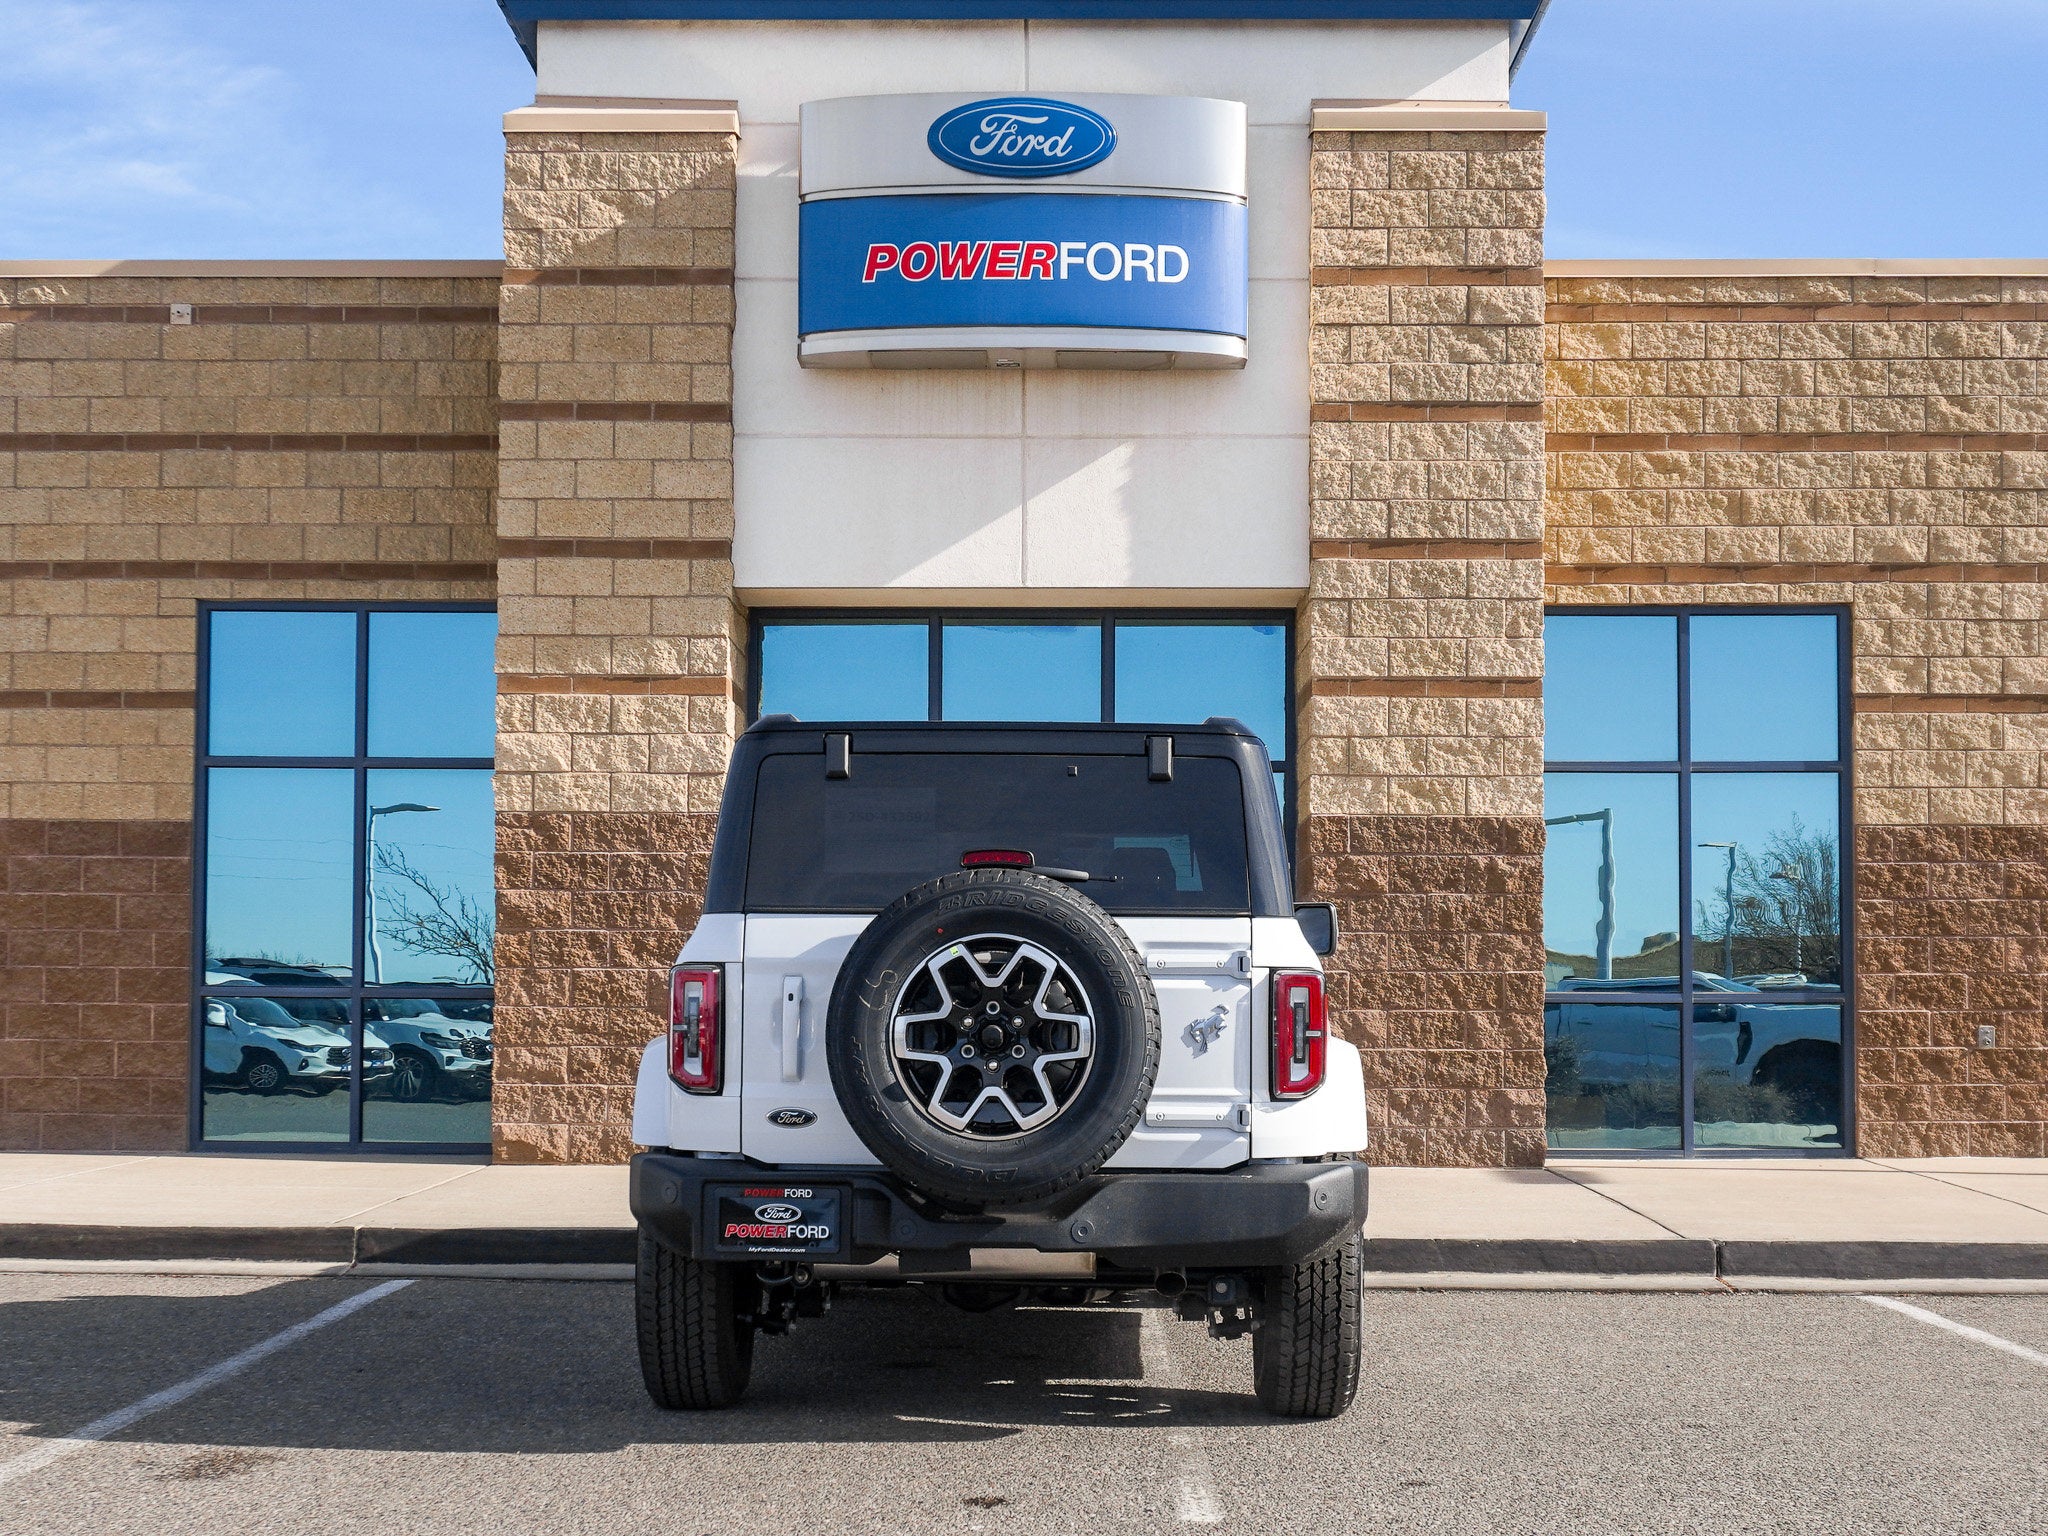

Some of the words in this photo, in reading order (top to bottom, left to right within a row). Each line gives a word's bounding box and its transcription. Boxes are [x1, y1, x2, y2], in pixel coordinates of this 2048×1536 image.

[969, 113, 1076, 158] Ford
[862, 241, 1190, 284] POWERFORD
[938, 889, 1136, 1009] BRIDGESTONE
[777, 1110, 806, 1125] Ford
[744, 1188, 813, 1198] POWERFORD
[763, 1206, 792, 1219] Ford
[725, 1223, 830, 1239] POWERFORD
[748, 1246, 806, 1254] MyFordDealer.com
